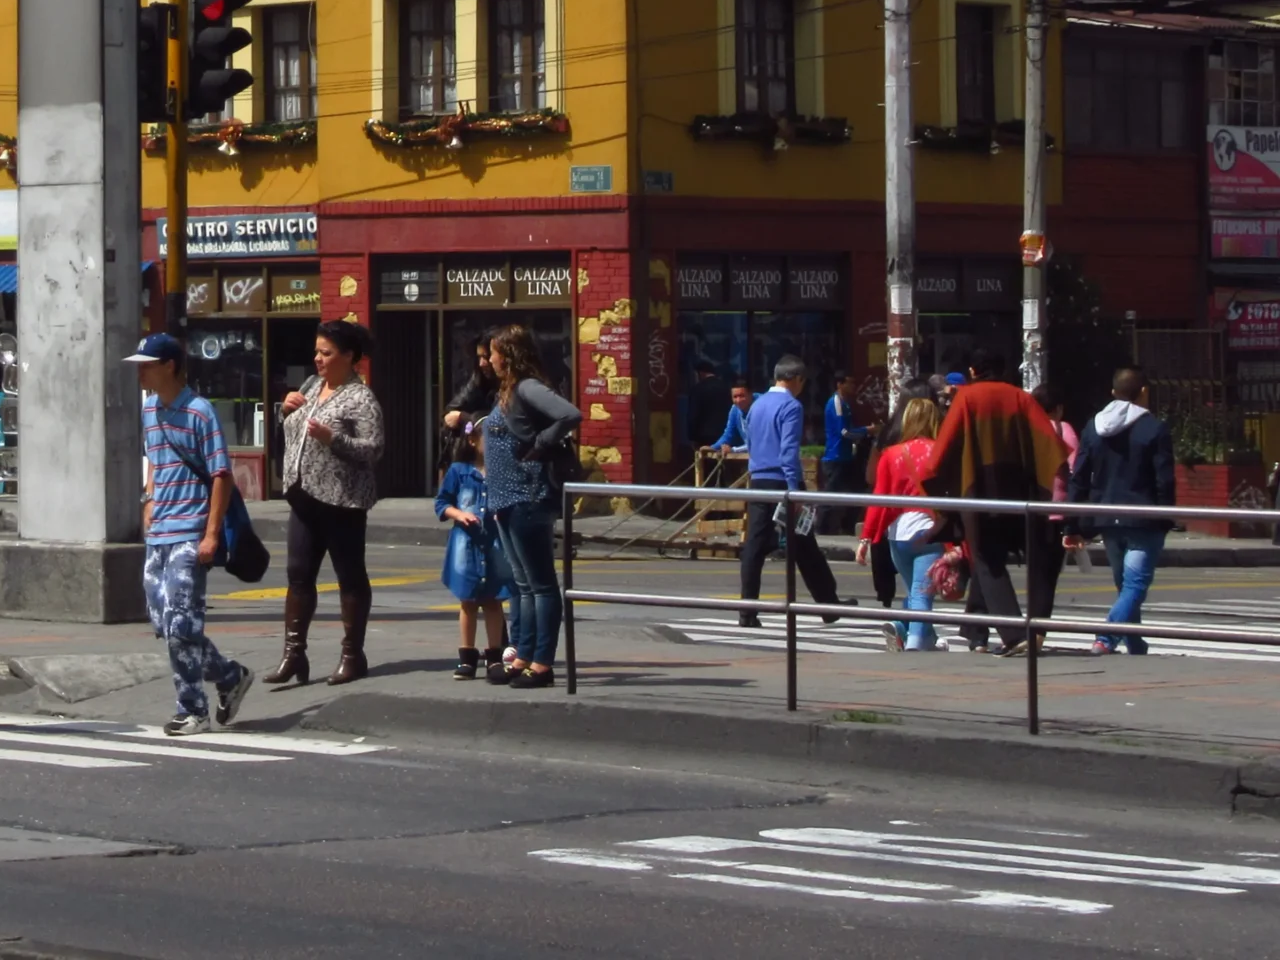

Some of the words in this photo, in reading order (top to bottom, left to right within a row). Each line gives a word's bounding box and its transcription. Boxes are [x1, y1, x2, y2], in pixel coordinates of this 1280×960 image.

[235, 217, 317, 236] SERVICIO
[460, 283, 494, 297] LINA
[528, 282, 561, 295] LINA
[681, 284, 710, 298] LINA
[742, 285, 771, 298] LINA
[801, 284, 828, 298] LINA
[976, 278, 1003, 292] LINA
